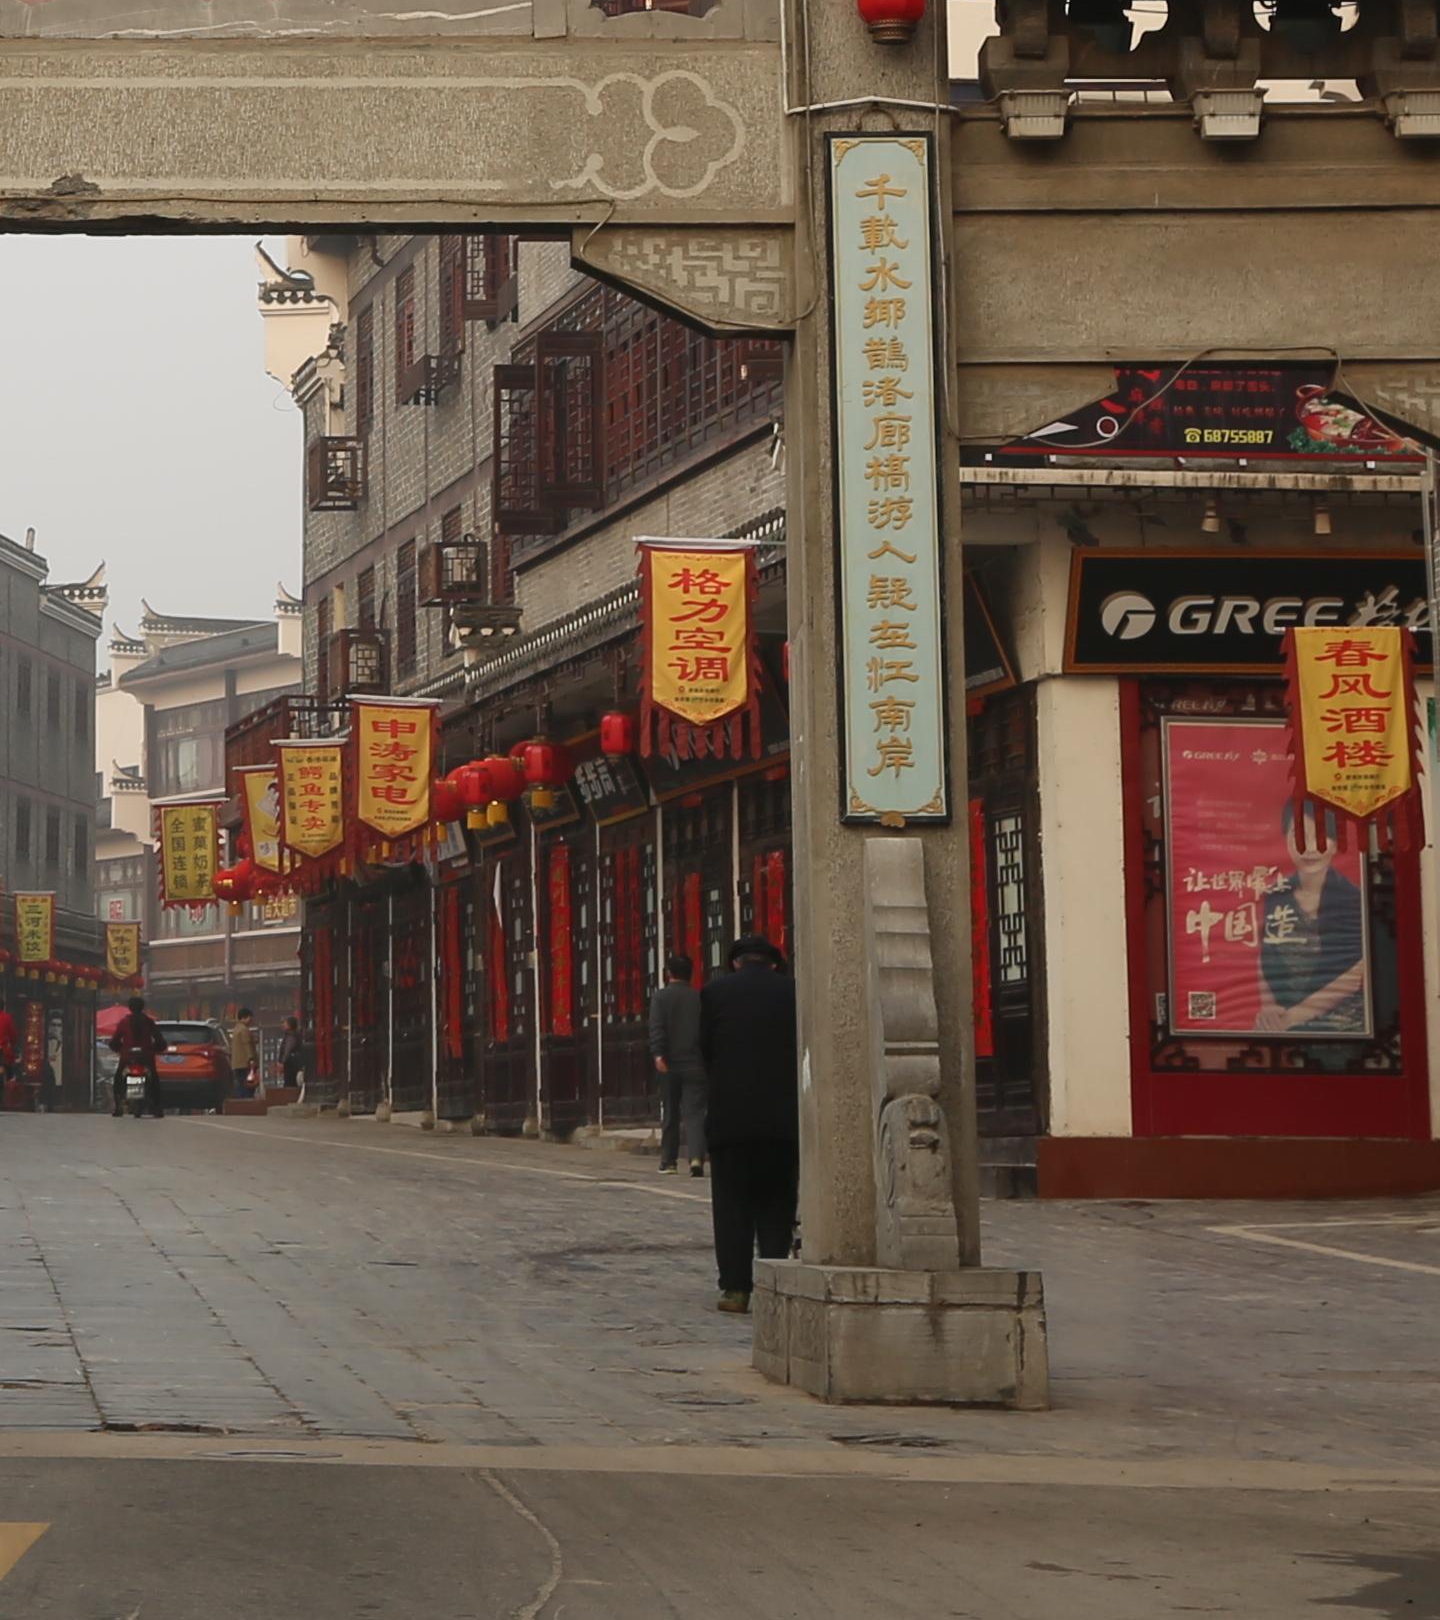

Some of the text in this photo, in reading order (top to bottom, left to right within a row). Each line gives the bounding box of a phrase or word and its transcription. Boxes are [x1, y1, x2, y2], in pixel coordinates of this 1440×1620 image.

[1204, 429, 1273, 443] 68755887
[668, 568, 732, 682] 格力空调
[1168, 595, 1344, 634] GREE
[1314, 639, 1395, 769] 春风酒楼
[367, 719, 419, 806] 申涛家电
[298, 766, 327, 830] 鳄鱼专卖
[171, 817, 188, 889] 全国连锁
[1186, 900, 1307, 963] 中国造
